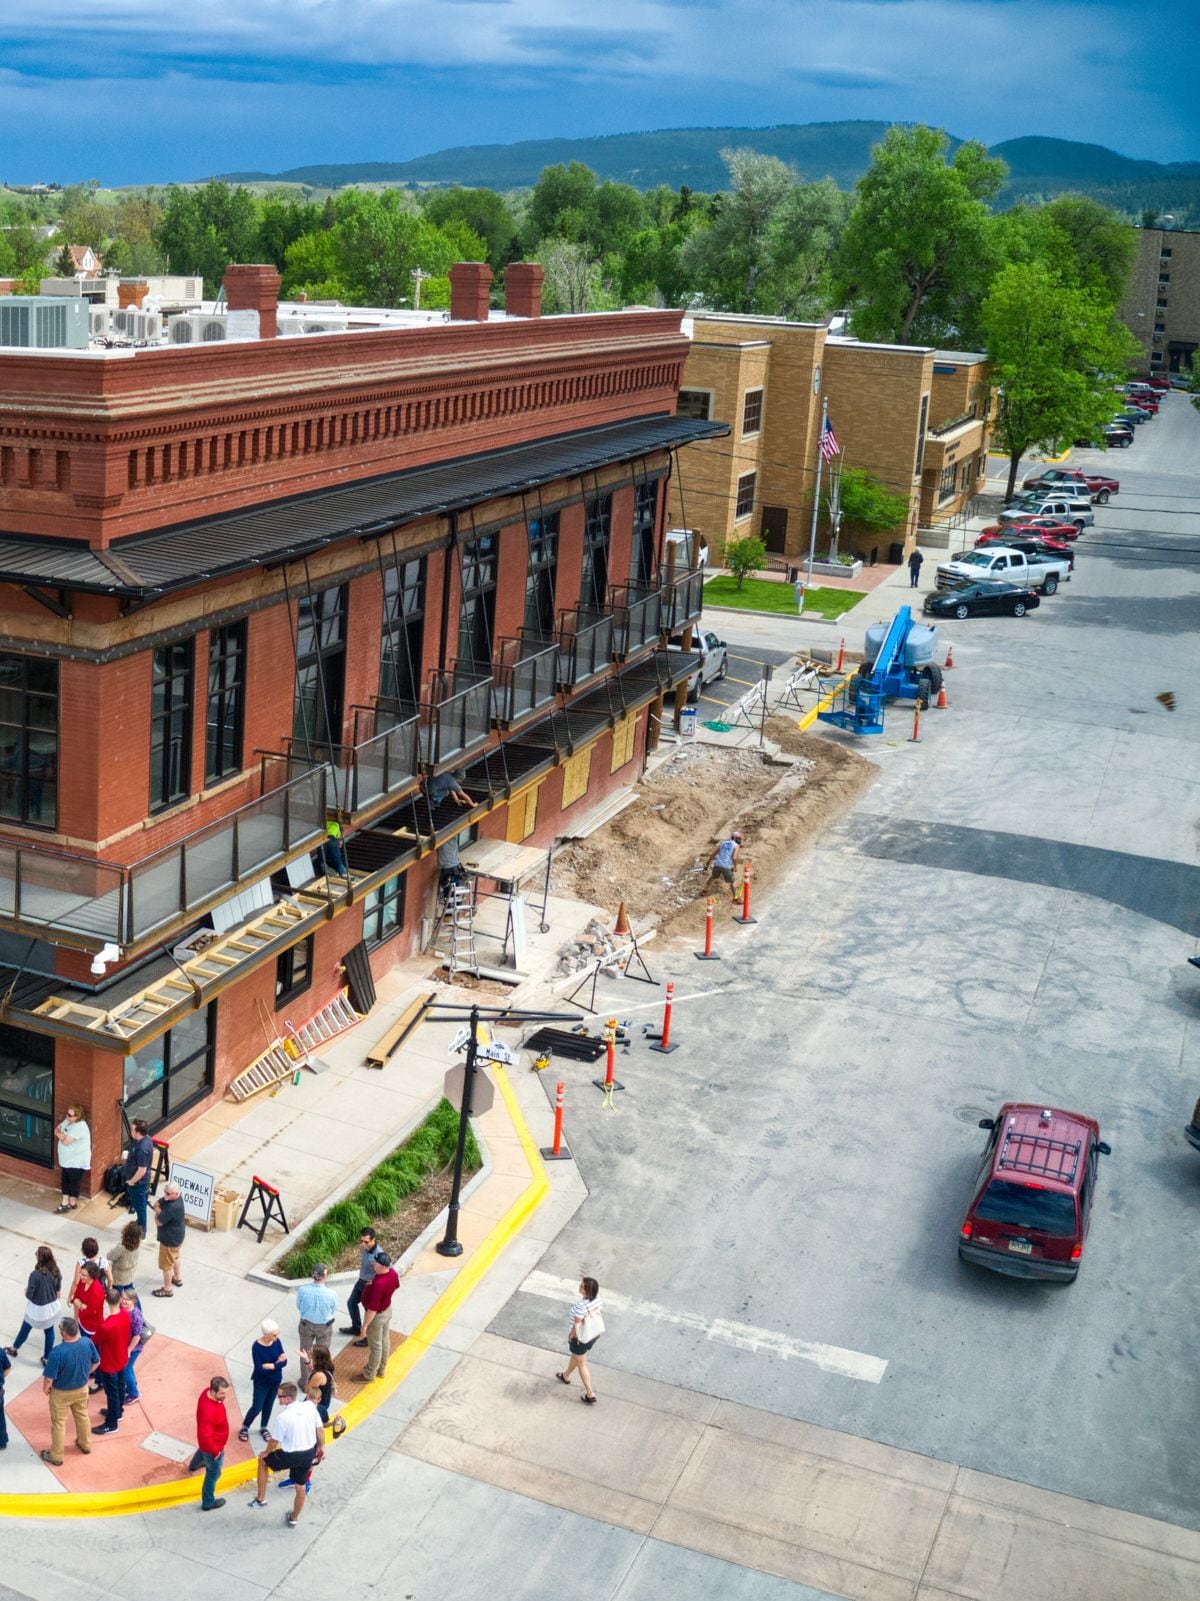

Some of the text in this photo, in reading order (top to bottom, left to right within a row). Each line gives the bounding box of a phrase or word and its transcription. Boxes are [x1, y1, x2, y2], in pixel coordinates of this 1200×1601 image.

[485, 1048, 511, 1062] Main St
[173, 1175, 210, 1196] SIDEWALK
[183, 1192, 204, 1208] OSED
